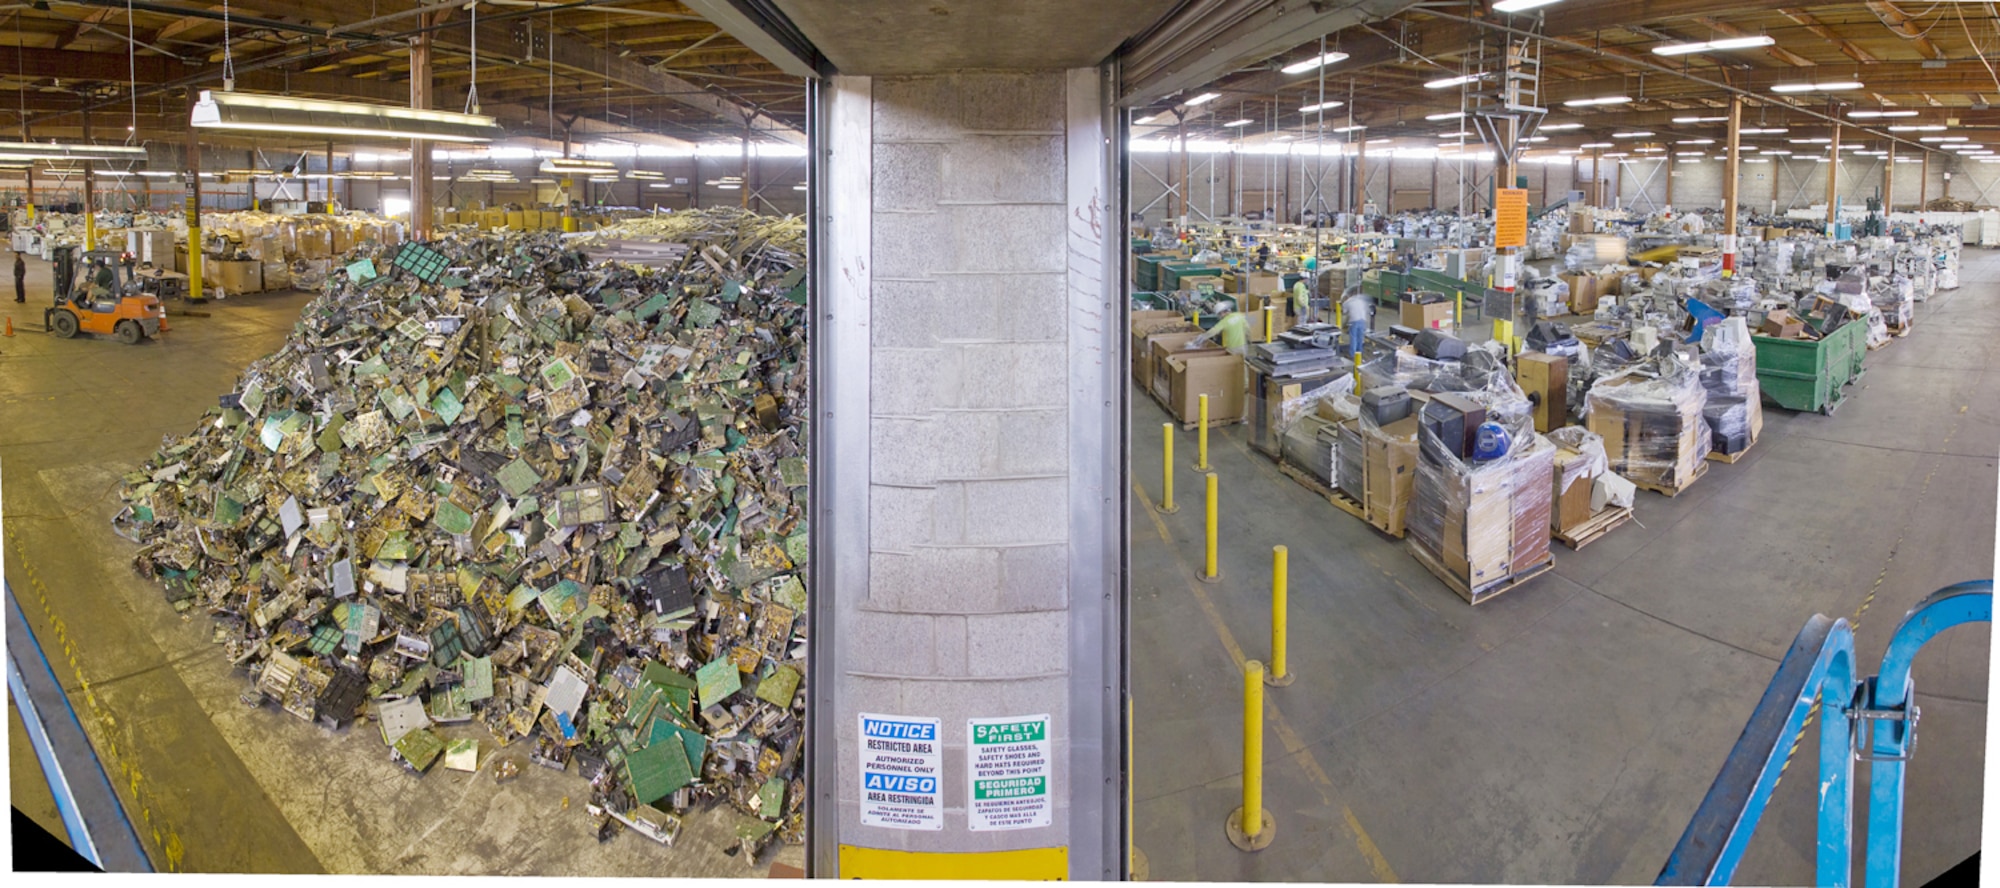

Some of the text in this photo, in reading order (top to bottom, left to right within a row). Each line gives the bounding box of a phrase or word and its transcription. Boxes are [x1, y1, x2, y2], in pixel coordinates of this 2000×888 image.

[866, 720, 933, 739] NOTICE
[976, 722, 1041, 738] SAFETY
[988, 732, 1032, 742] FIRST
[867, 739, 933, 754] RESTRICTED AREA
[1007, 744, 1038, 752] GLASSES,
[875, 755, 925, 765] AUTHORIZED
[1004, 752, 1026, 760] SHOES
[866, 762, 935, 774] PERSONNEL ONLY
[1012, 758, 1046, 767] REQUIRED
[867, 774, 935, 792] AVISO
[978, 777, 1042, 790] SEGURIDAD
[986, 786, 1036, 798] PRIMERO
[867, 792, 935, 805] AREA RESTRINGIDA
[880, 816, 922, 824] AUTORIZADO
